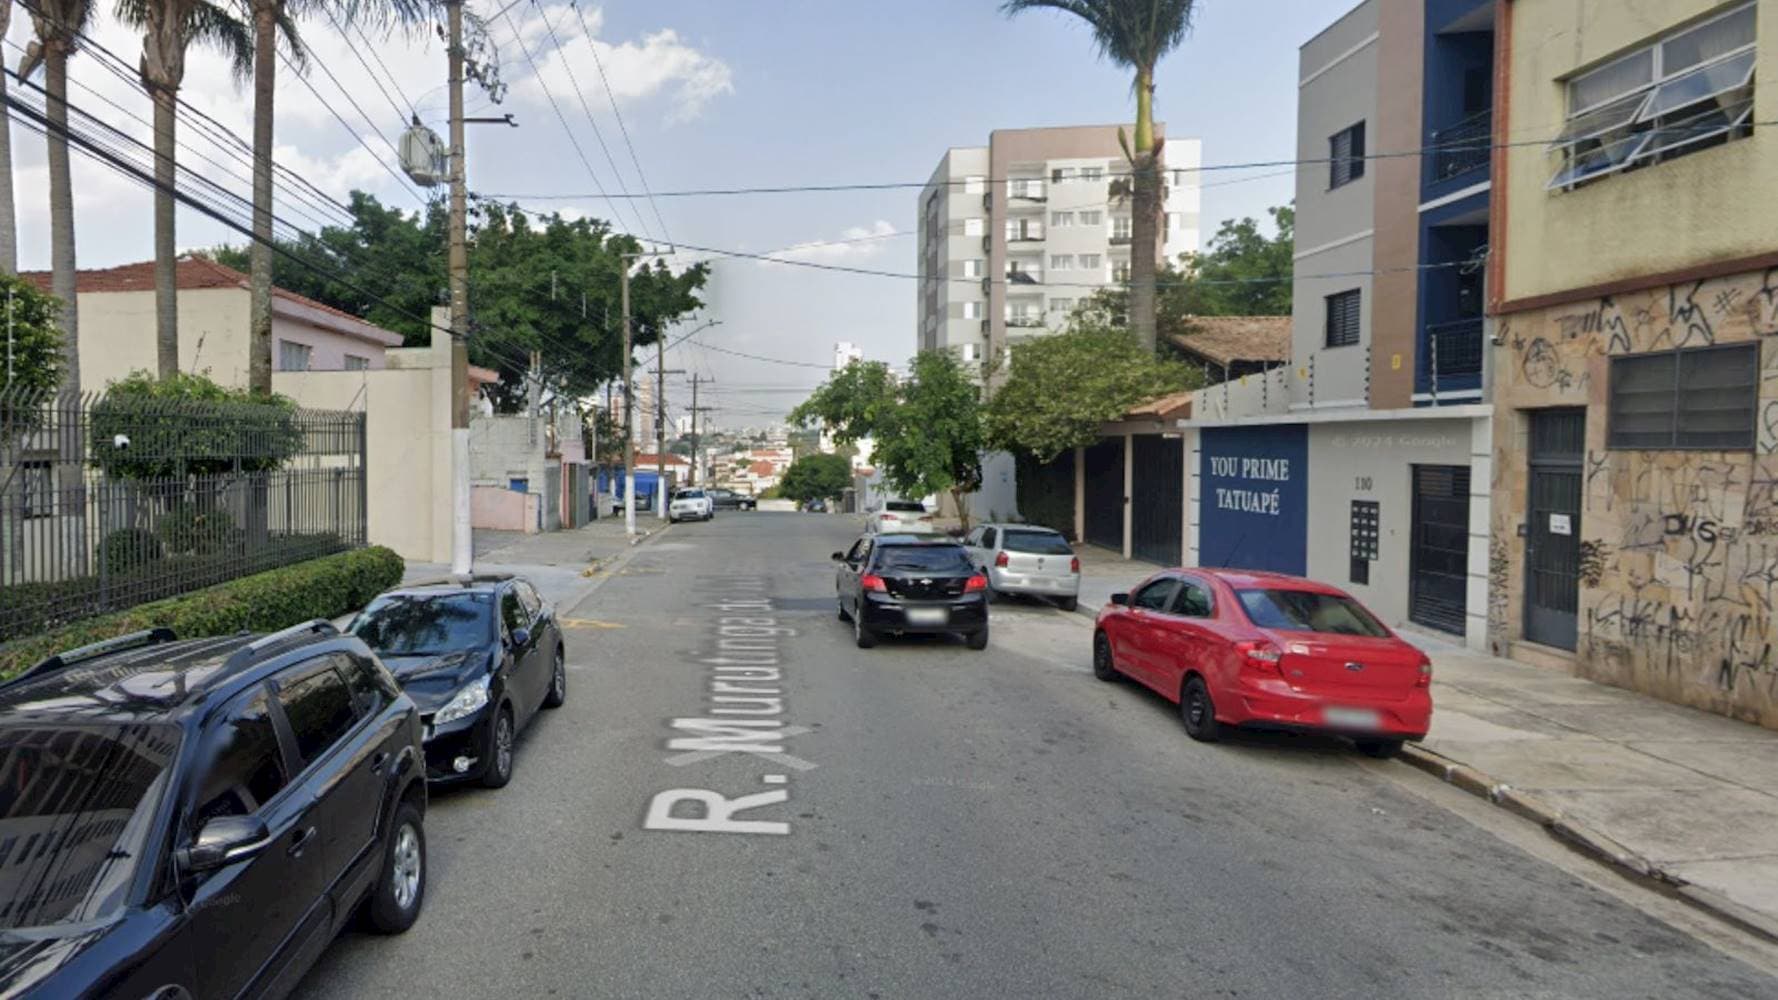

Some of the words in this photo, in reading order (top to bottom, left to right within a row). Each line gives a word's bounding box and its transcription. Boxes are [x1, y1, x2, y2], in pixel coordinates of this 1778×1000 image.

[1211, 456, 1238, 477] YOU
[1241, 459, 1289, 481] PRIME
[1216, 488, 1280, 515] TATUAPÉ
